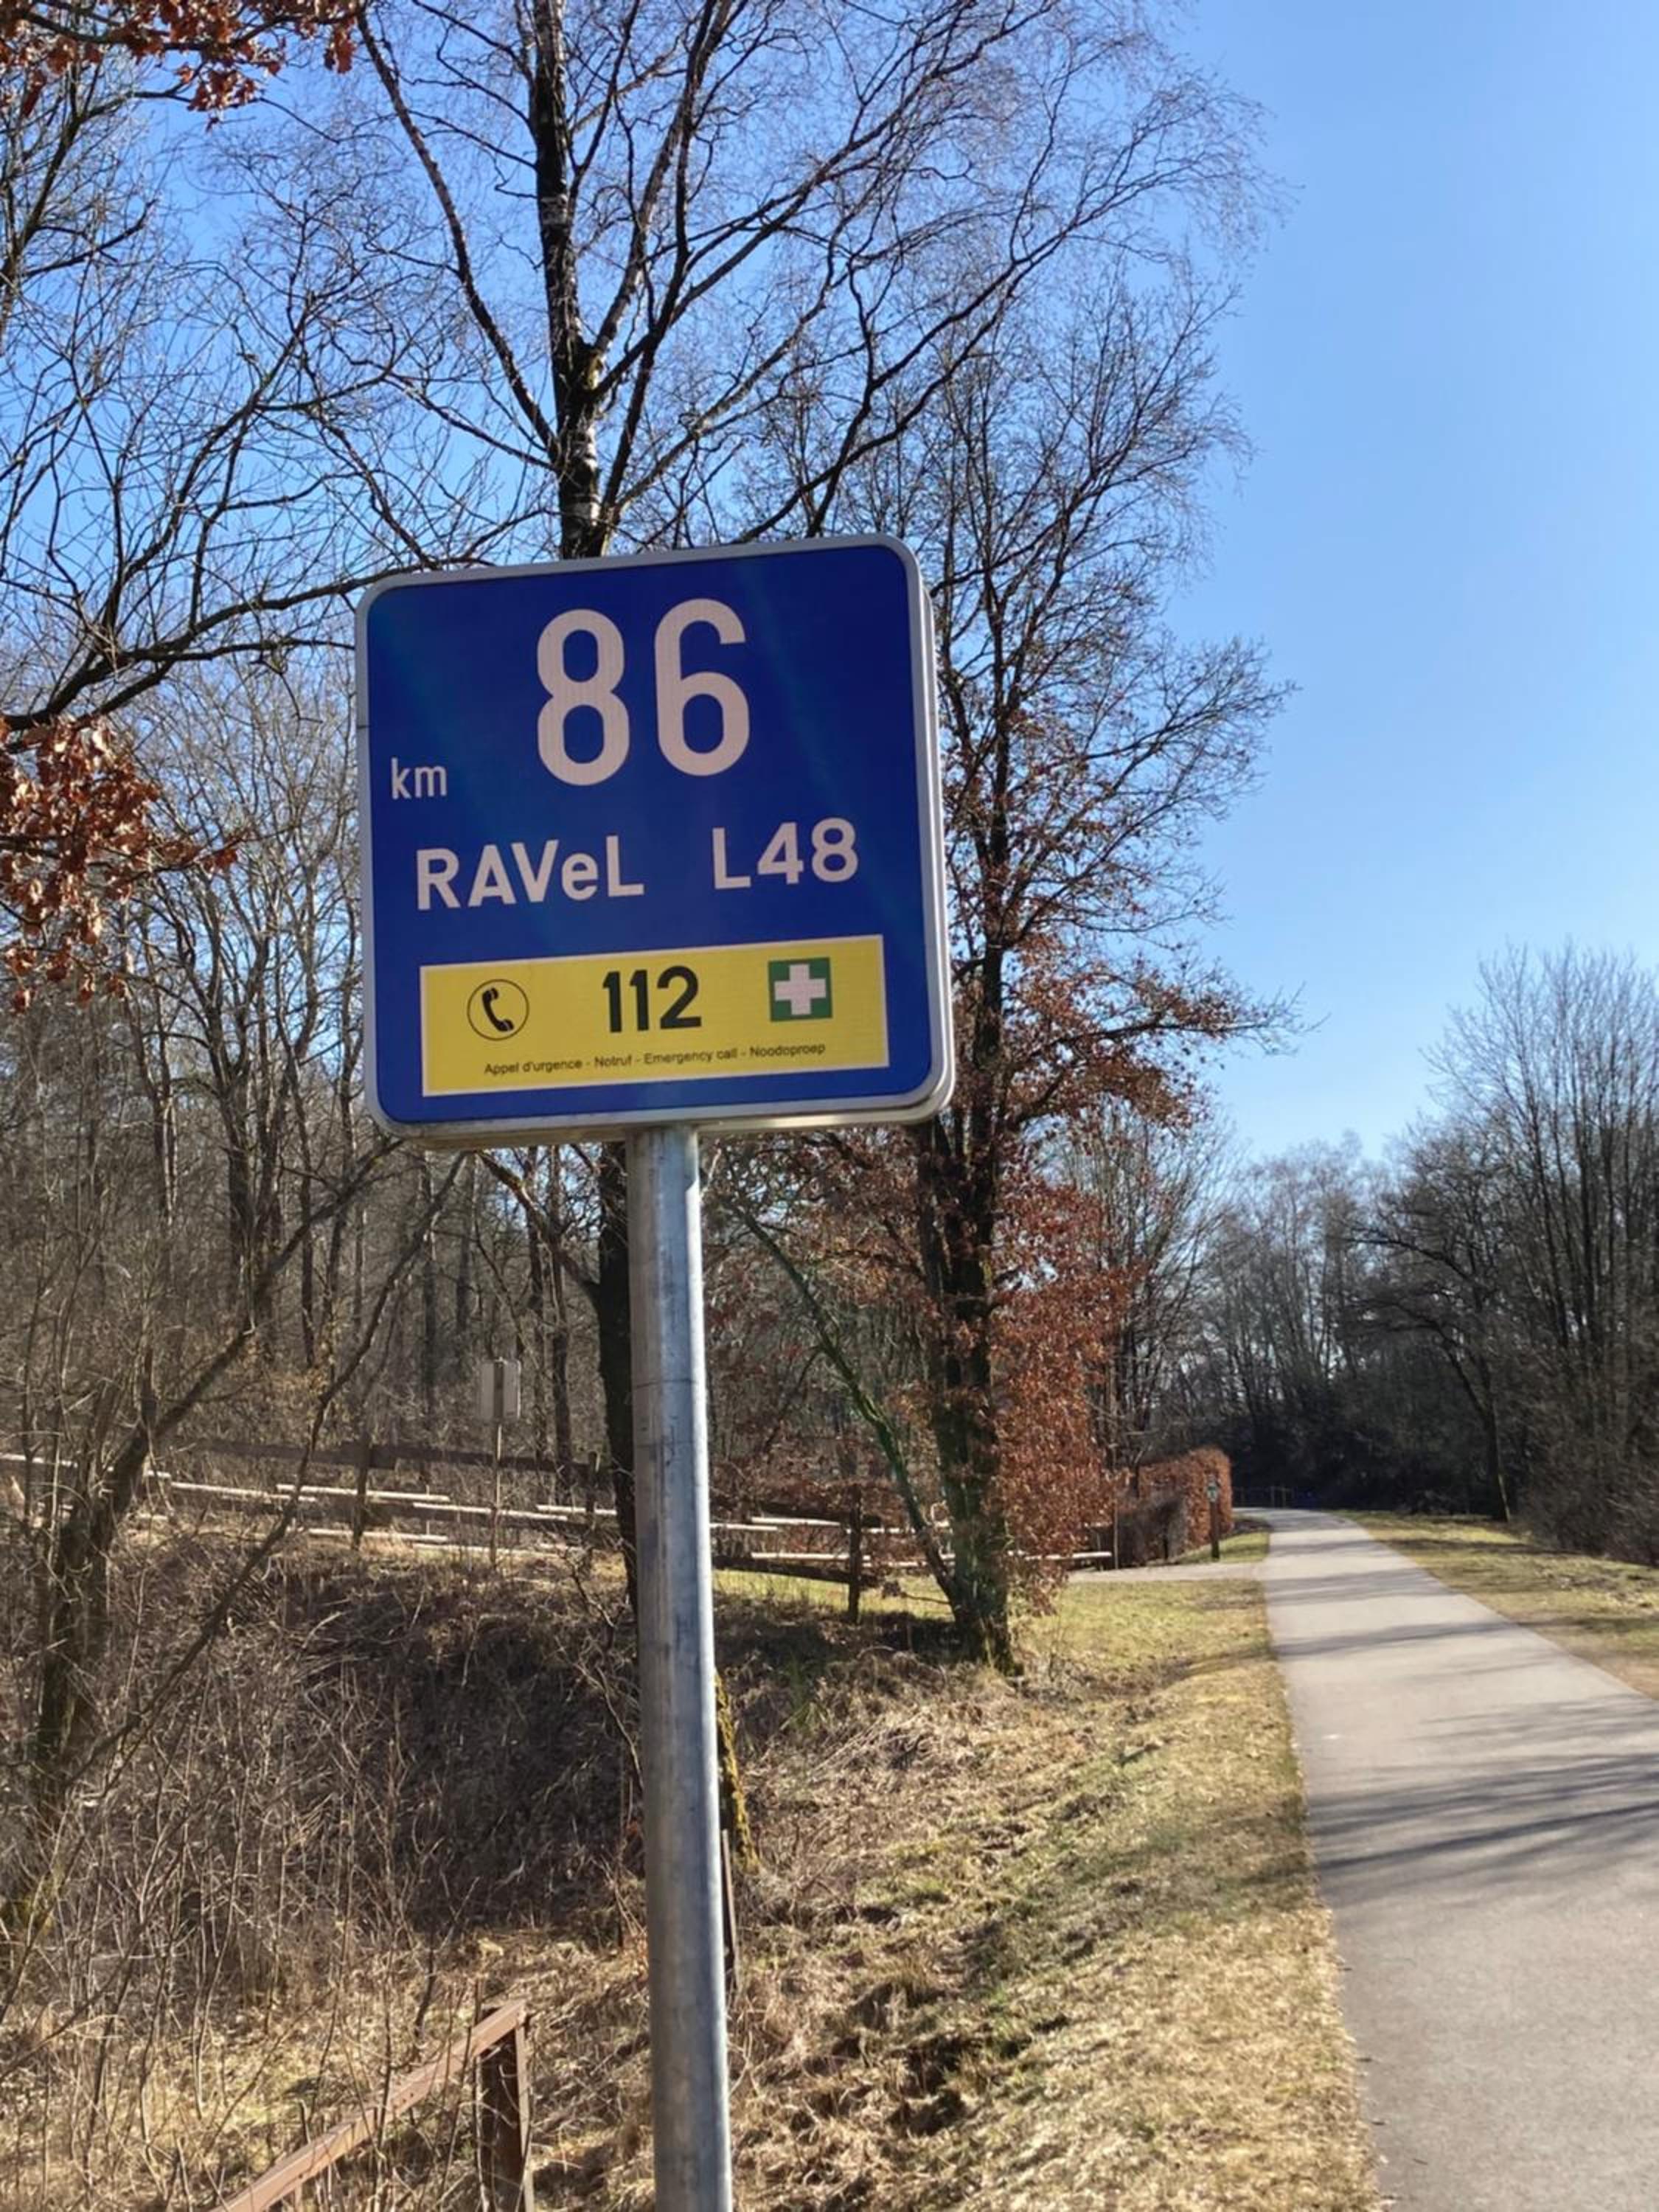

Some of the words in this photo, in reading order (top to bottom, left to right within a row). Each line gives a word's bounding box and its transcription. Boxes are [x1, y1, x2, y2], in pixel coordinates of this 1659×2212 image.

[392, 758, 446, 799] km
[538, 599, 749, 785] 86
[417, 835, 644, 910] RAVeL
[713, 818, 858, 889] L48
[602, 965, 702, 1033] 112
[484, 1061, 519, 1076] Appel
[522, 1060, 583, 1073] d'urgence
[594, 1054, 633, 1068] Notruf
[644, 1050, 713, 1064] Emergency
[716, 1047, 737, 1060] call
[749, 1043, 826, 1057] Noodoproep
